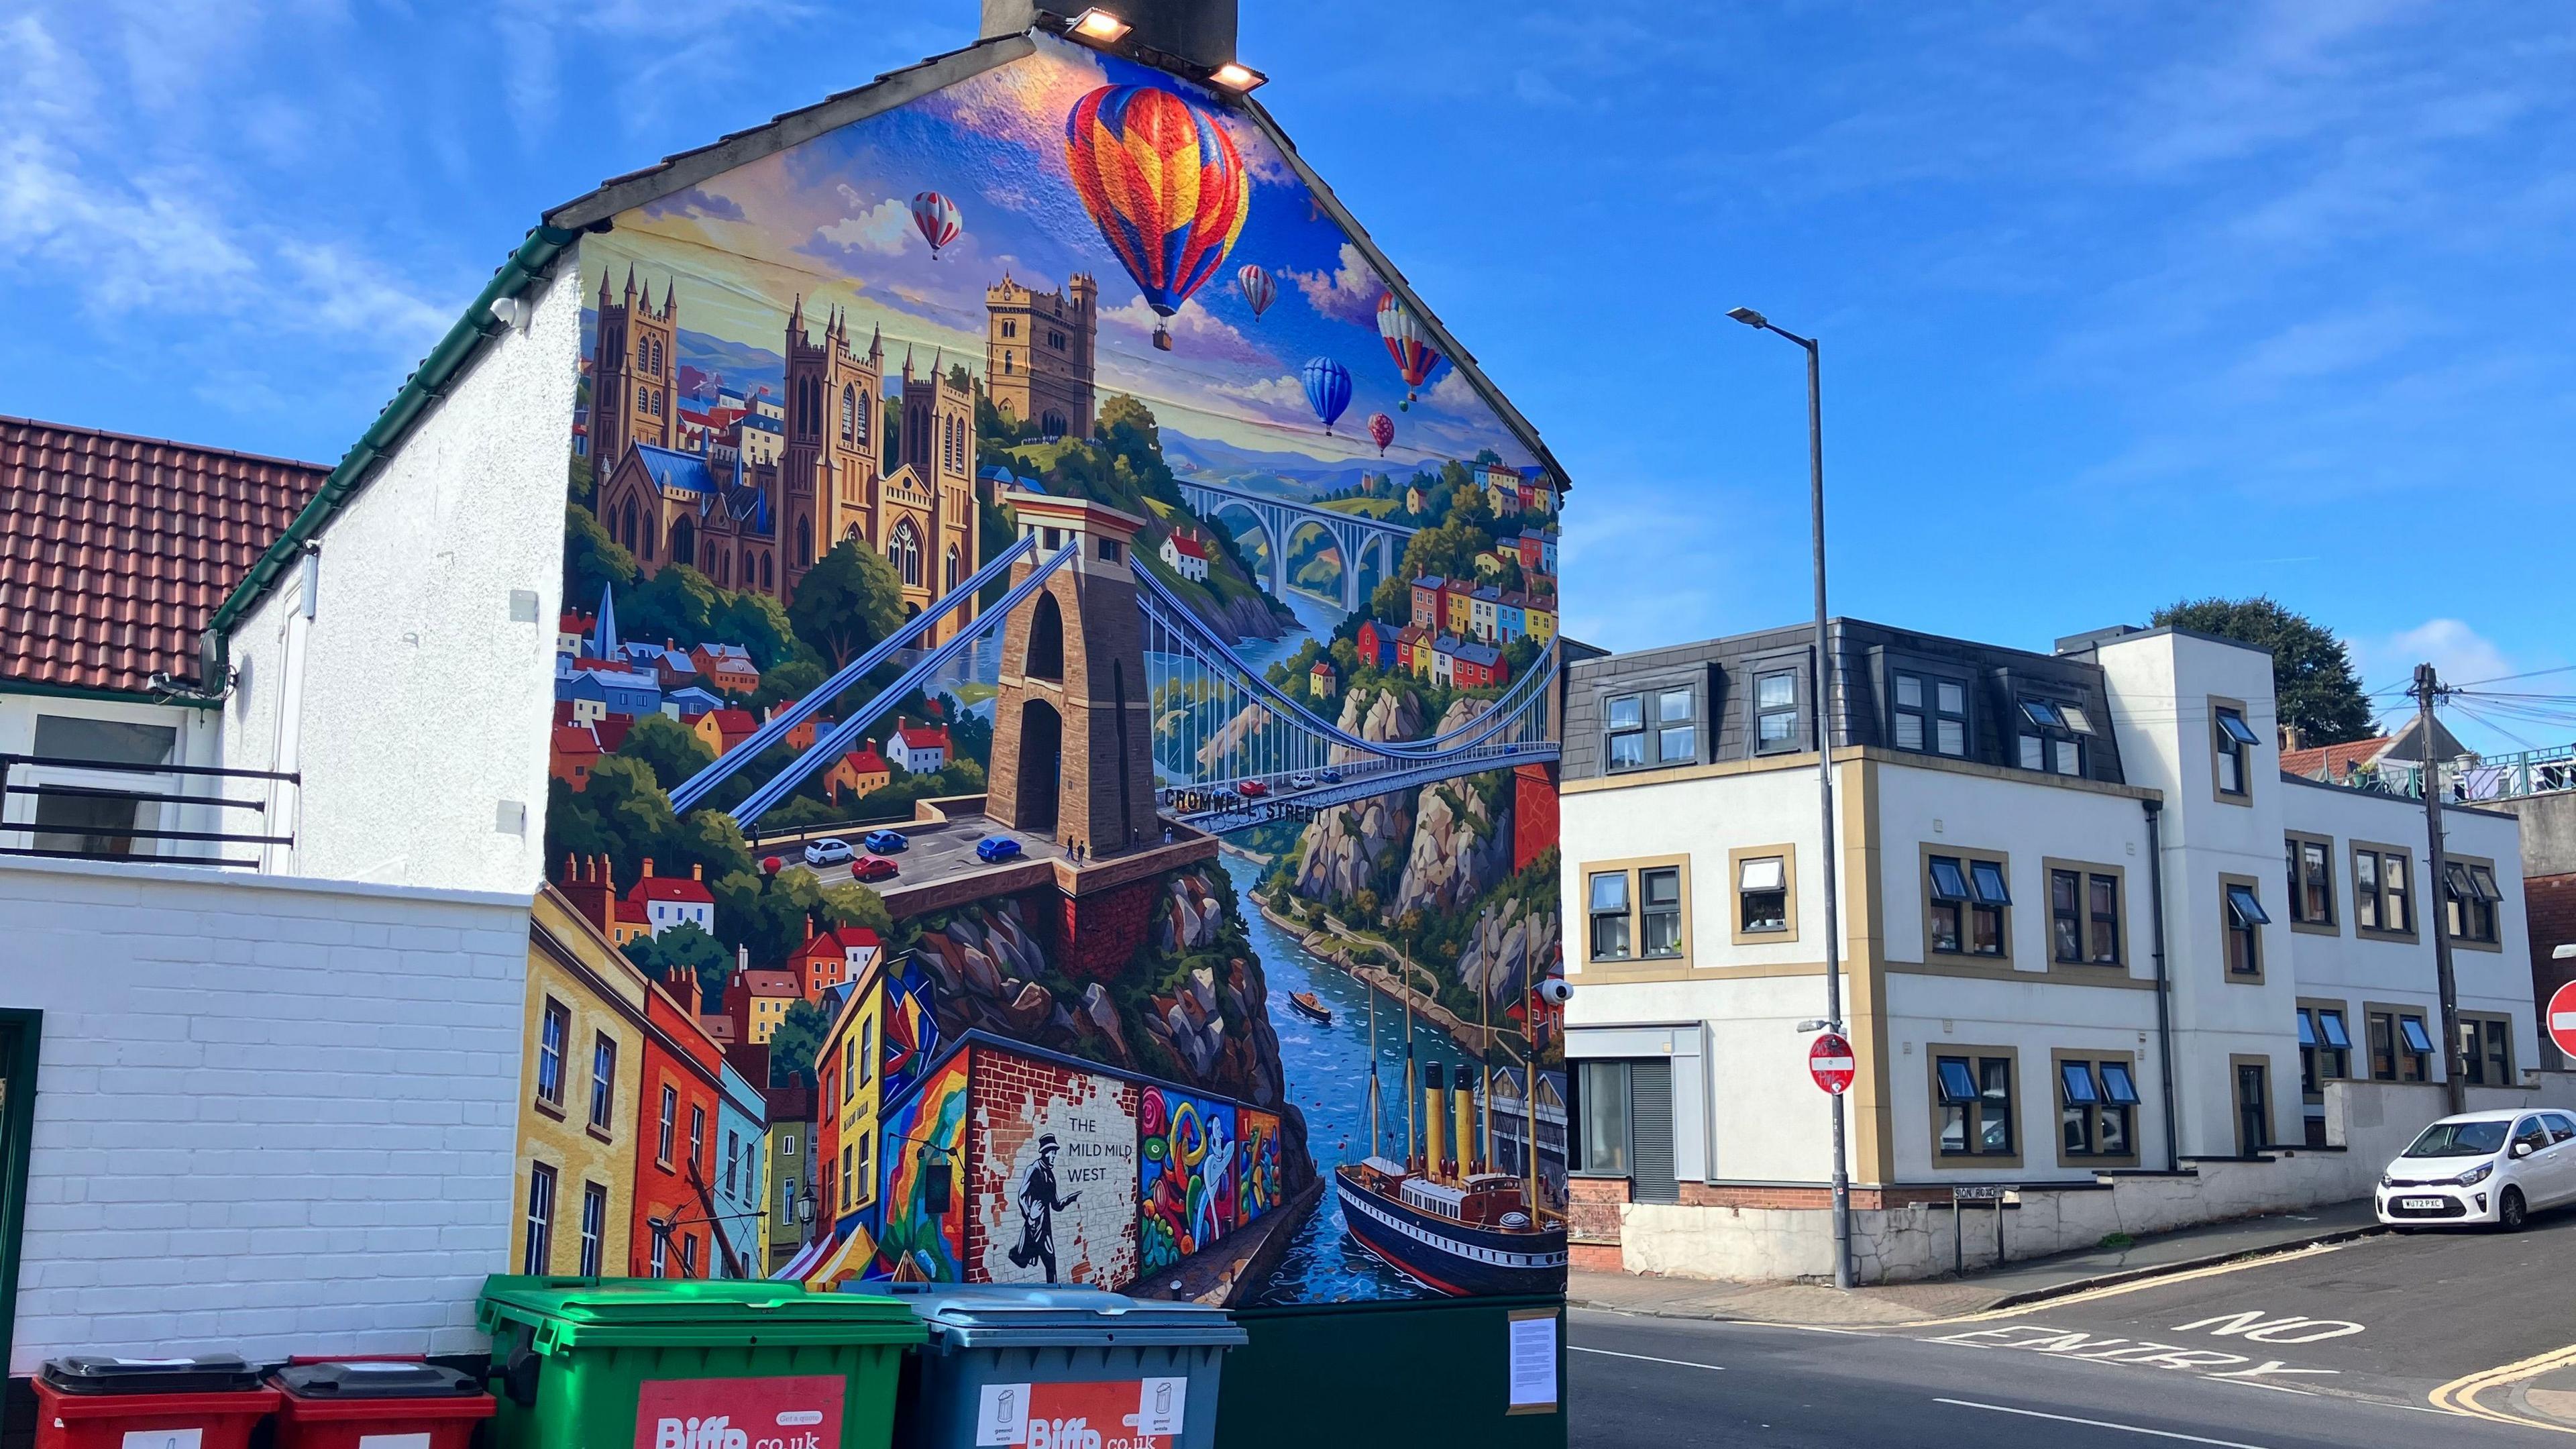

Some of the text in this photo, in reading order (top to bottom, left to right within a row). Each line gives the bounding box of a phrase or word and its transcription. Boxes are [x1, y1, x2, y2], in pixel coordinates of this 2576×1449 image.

[1165, 788, 1324, 825] CROMWELL STREET
[1069, 1118, 1096, 1132] THE
[1069, 1143, 1132, 1157] MILD MILD
[1067, 1168, 1106, 1183] WEST
[2170, 1311, 2365, 1343] NO
[1928, 1326, 2341, 1376] ENTRY
[656, 1415, 748, 1449] Biffa
[1027, 1417, 1101, 1449] Biffa
